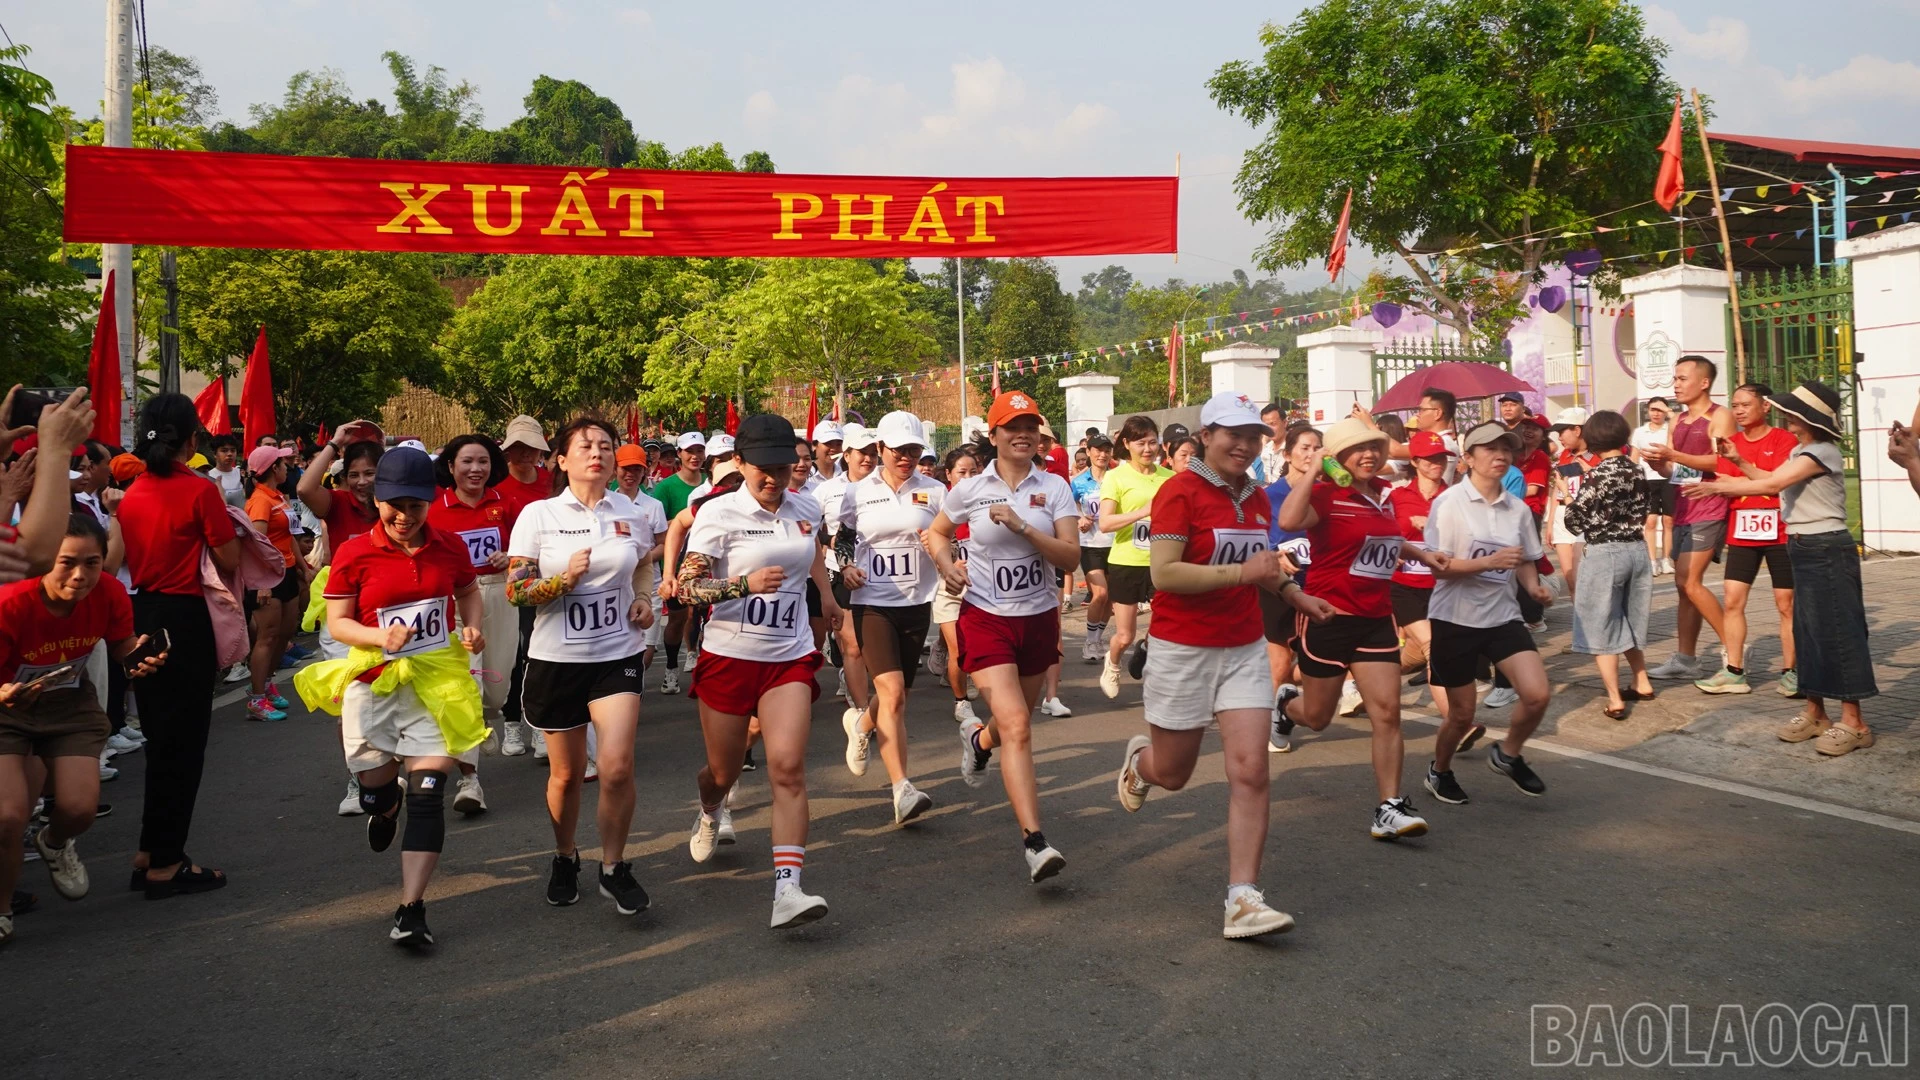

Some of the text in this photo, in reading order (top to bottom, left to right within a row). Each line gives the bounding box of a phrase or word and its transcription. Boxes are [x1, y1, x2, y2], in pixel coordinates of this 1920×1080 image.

[376, 168, 1004, 243] XUẤT PHÁT
[1741, 514, 1773, 533] 156
[872, 552, 913, 577] 011
[1360, 543, 1399, 570] 008
[996, 560, 1043, 592] 026
[568, 595, 618, 632] 015
[747, 596, 797, 629] 014
[39, 641, 57, 656] YÊU
[58, 636, 81, 651] VIỆT
[82, 635, 100, 648] NA
